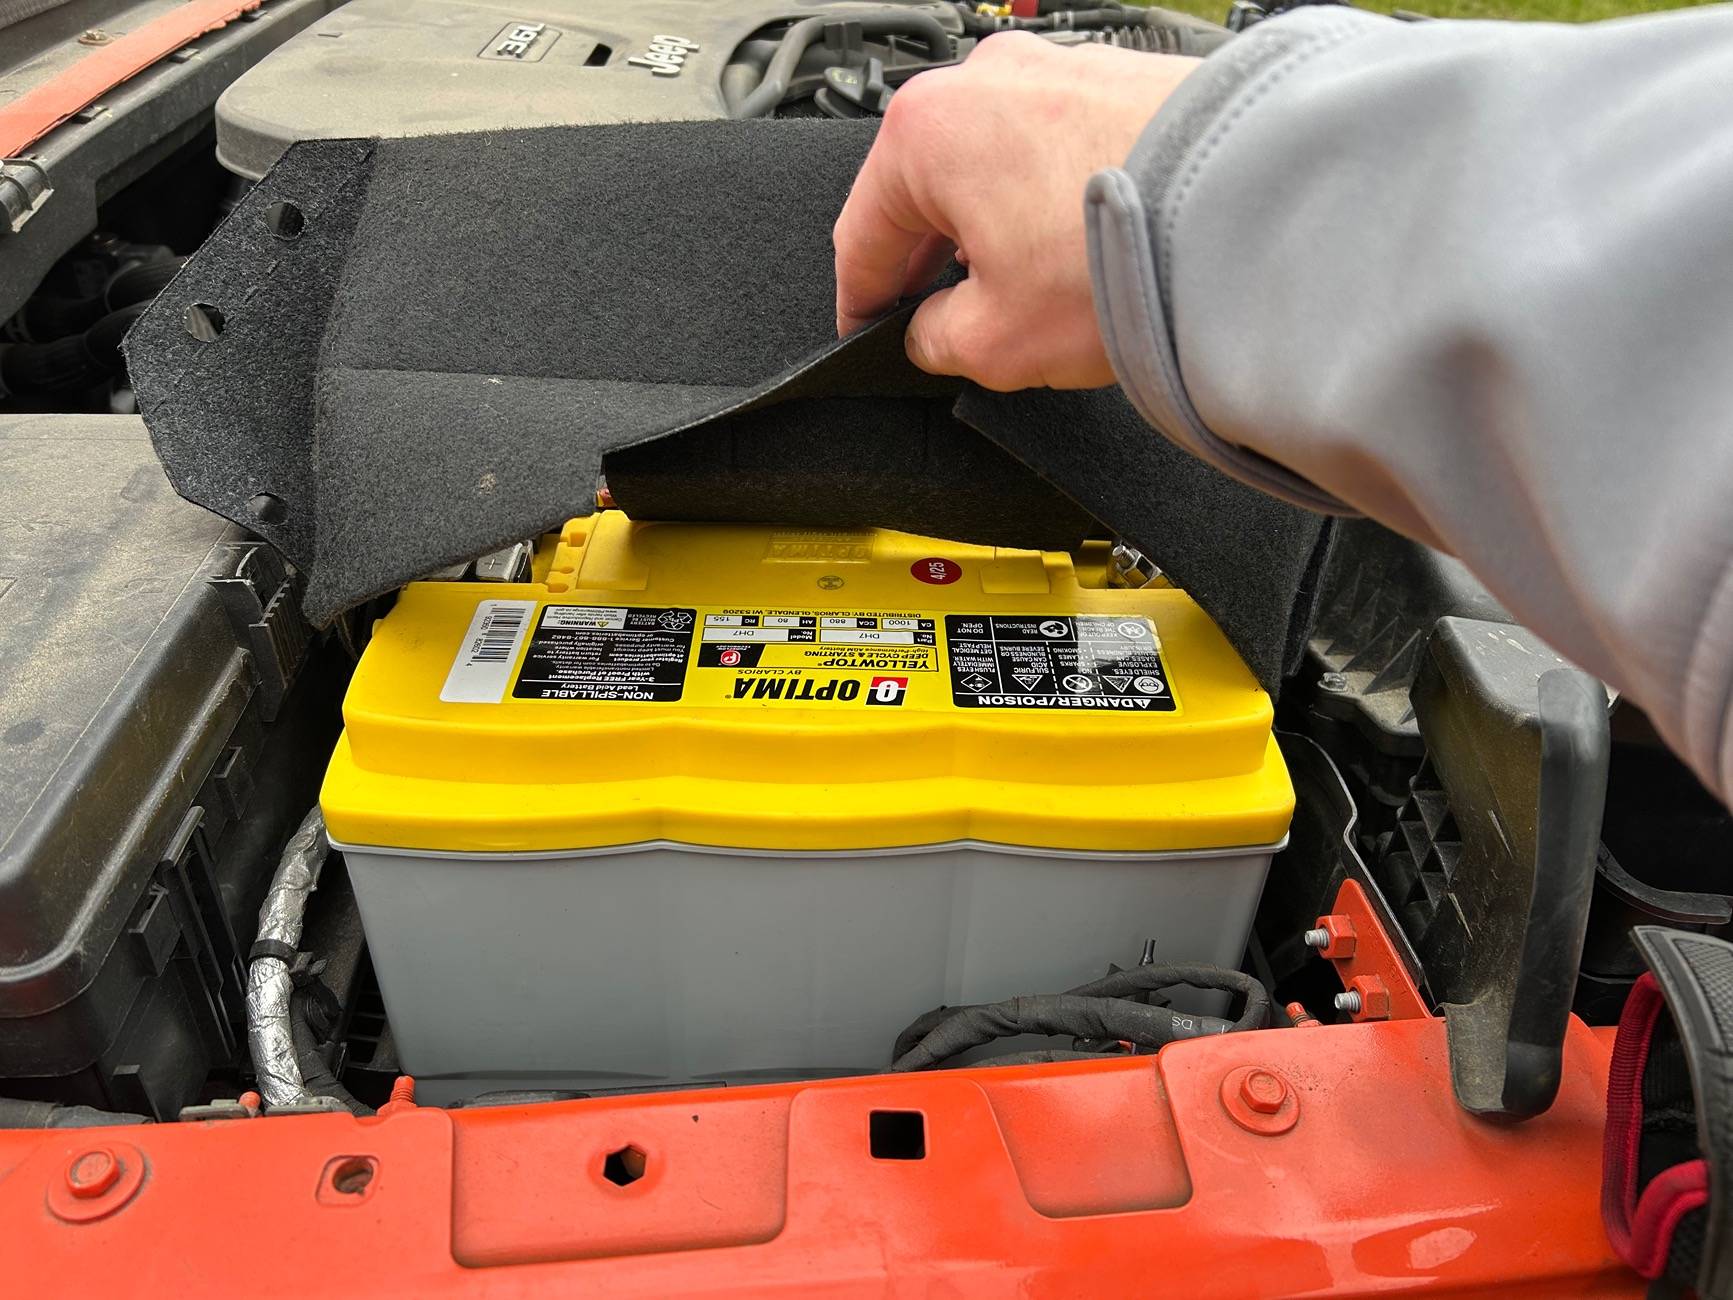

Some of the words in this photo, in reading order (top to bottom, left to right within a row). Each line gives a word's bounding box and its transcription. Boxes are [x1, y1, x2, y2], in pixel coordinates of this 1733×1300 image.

[628, 34, 699, 78] Jeep
[928, 562, 947, 580] 4/25
[823, 658, 929, 669] YELLOWTOP
[541, 689, 654, 700] NON-SPILLABLE
[733, 678, 861, 701] OPTIMA
[978, 696, 1134, 707] DANGER/POISON
